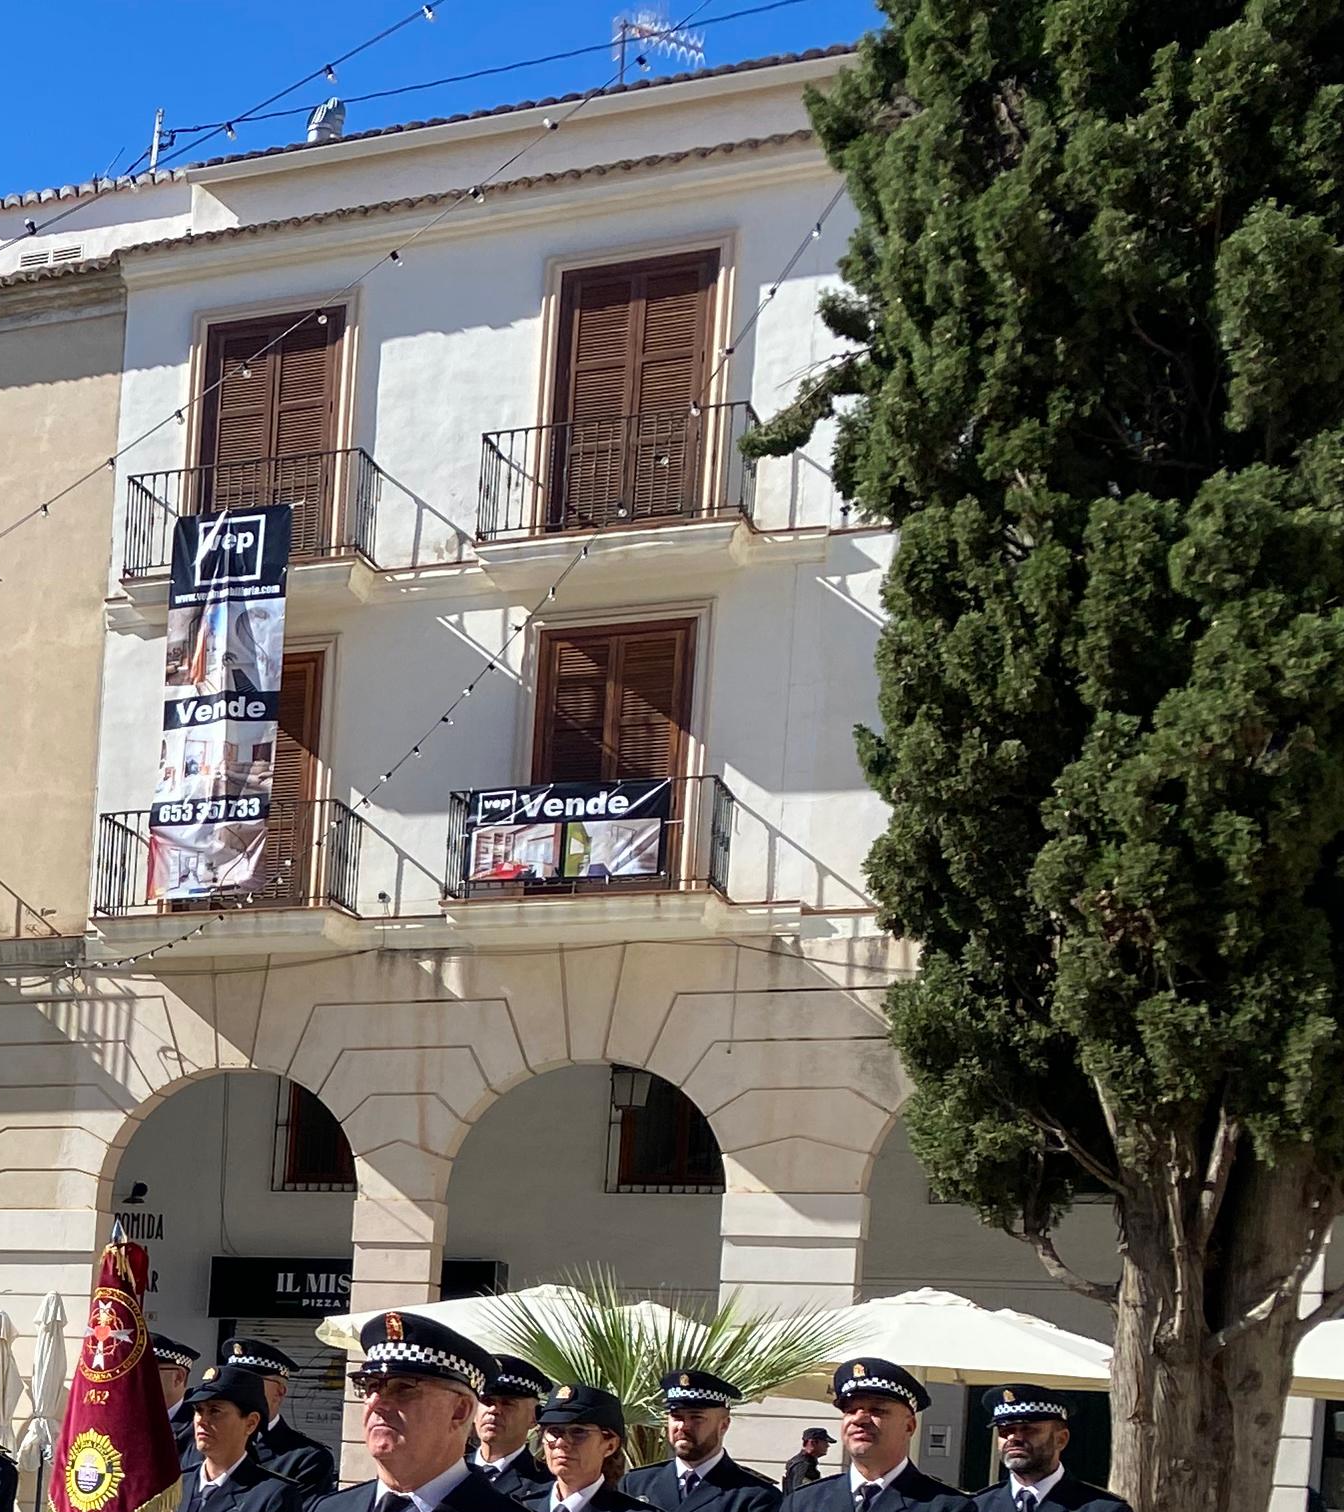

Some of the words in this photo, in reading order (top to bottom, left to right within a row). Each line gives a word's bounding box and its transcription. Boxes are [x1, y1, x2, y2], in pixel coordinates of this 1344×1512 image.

[176, 696, 266, 724] Vende
[159, 803, 193, 823] 653
[196, 800, 226, 821] 357
[228, 798, 260, 818] 733
[520, 791, 630, 817] Vende
[276, 1273, 300, 1293] IL
[302, 1299, 341, 1308] PIZZA
